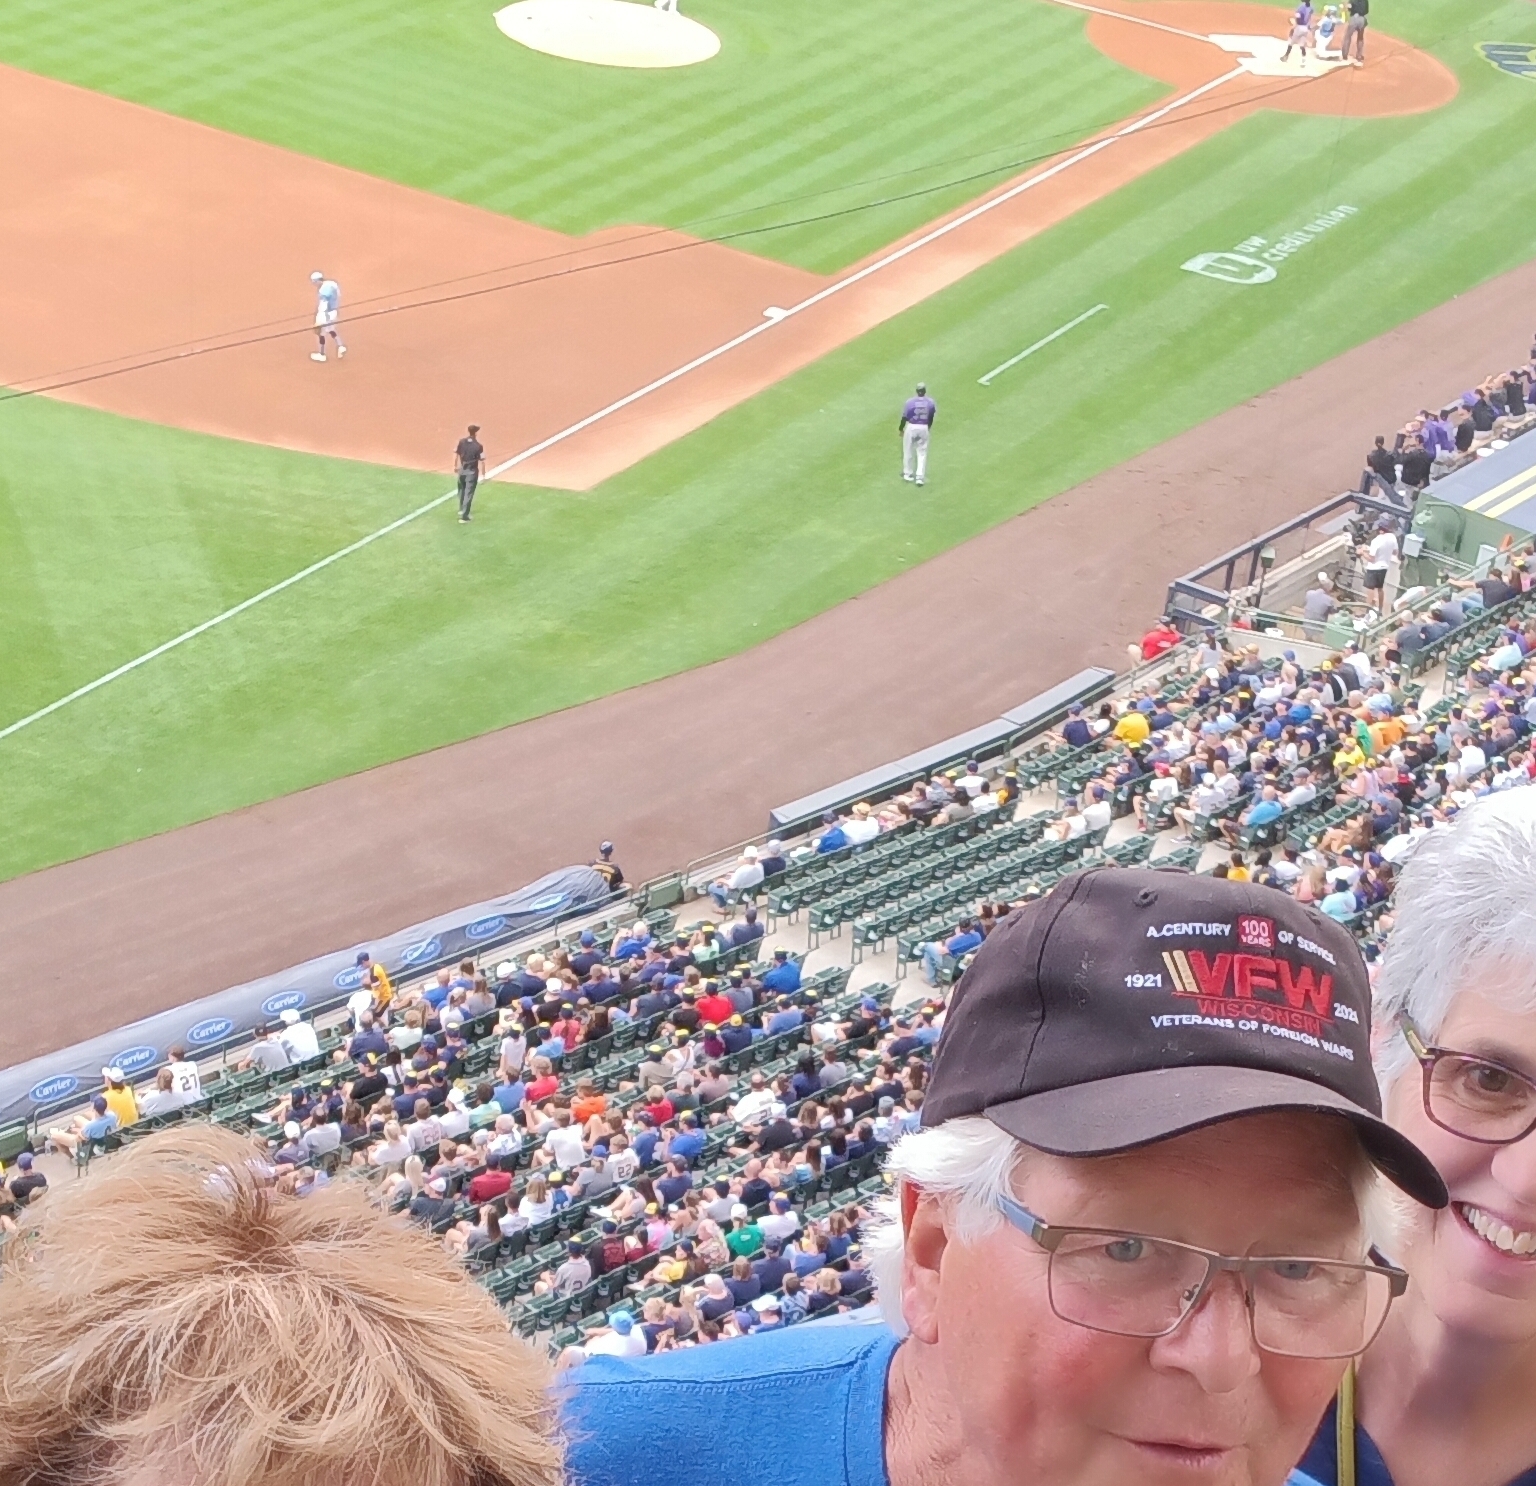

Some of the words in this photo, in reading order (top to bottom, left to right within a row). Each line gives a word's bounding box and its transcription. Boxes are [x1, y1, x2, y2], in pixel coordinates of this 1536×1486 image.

[469, 917, 503, 935] Carrier
[1162, 922, 1232, 937] CENTURY
[1241, 919, 1269, 937] 100
[1124, 973, 1162, 988] 1921
[1187, 950, 1334, 1016] VFW
[267, 992, 302, 1013] Carrier
[1196, 998, 1324, 1037] WISCONSIN
[191, 1020, 229, 1040] Carrier
[1150, 1014, 1235, 1029] VETERANS
[1238, 1019, 1259, 1031] OF
[1262, 1023, 1319, 1048] FOREIGN
[1320, 1039, 1354, 1061] WARS
[114, 1048, 153, 1069] Carrier
[34, 1076, 75, 1098] Carrier
